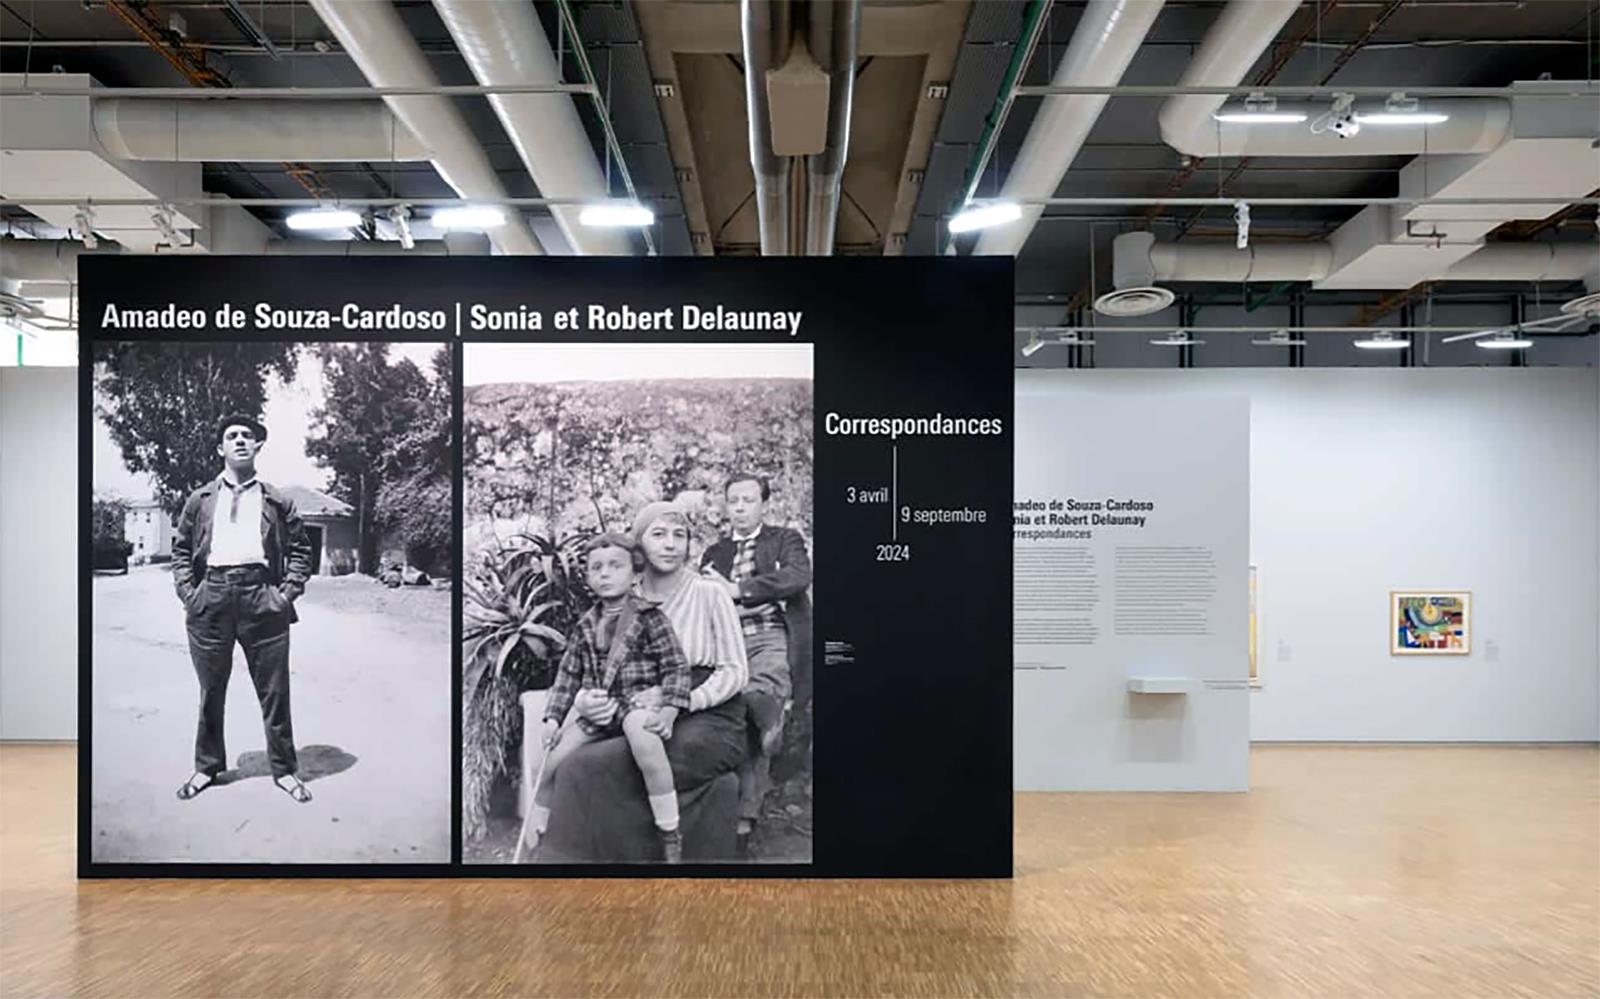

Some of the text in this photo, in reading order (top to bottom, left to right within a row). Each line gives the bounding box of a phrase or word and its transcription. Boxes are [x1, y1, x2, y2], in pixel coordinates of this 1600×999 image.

[101, 303, 207, 329] Amadeo
[215, 303, 246, 329] de
[254, 302, 447, 330] Souza-Cardoso
[470, 303, 543, 331] Sonia
[553, 307, 580, 330] et
[588, 304, 674, 331] Robert
[682, 304, 802, 336] Delaunay
[825, 412, 1002, 440] Correspondances
[847, 486, 889, 504] 3 avril
[1013, 498, 1154, 511] madeo de Souza-Cardoso
[901, 506, 987, 526] 9 septembre
[1013, 513, 1147, 528] nia et Robert Delaunay
[1013, 528, 1092, 541] rrespondances
[876, 544, 910, 561] 2024
